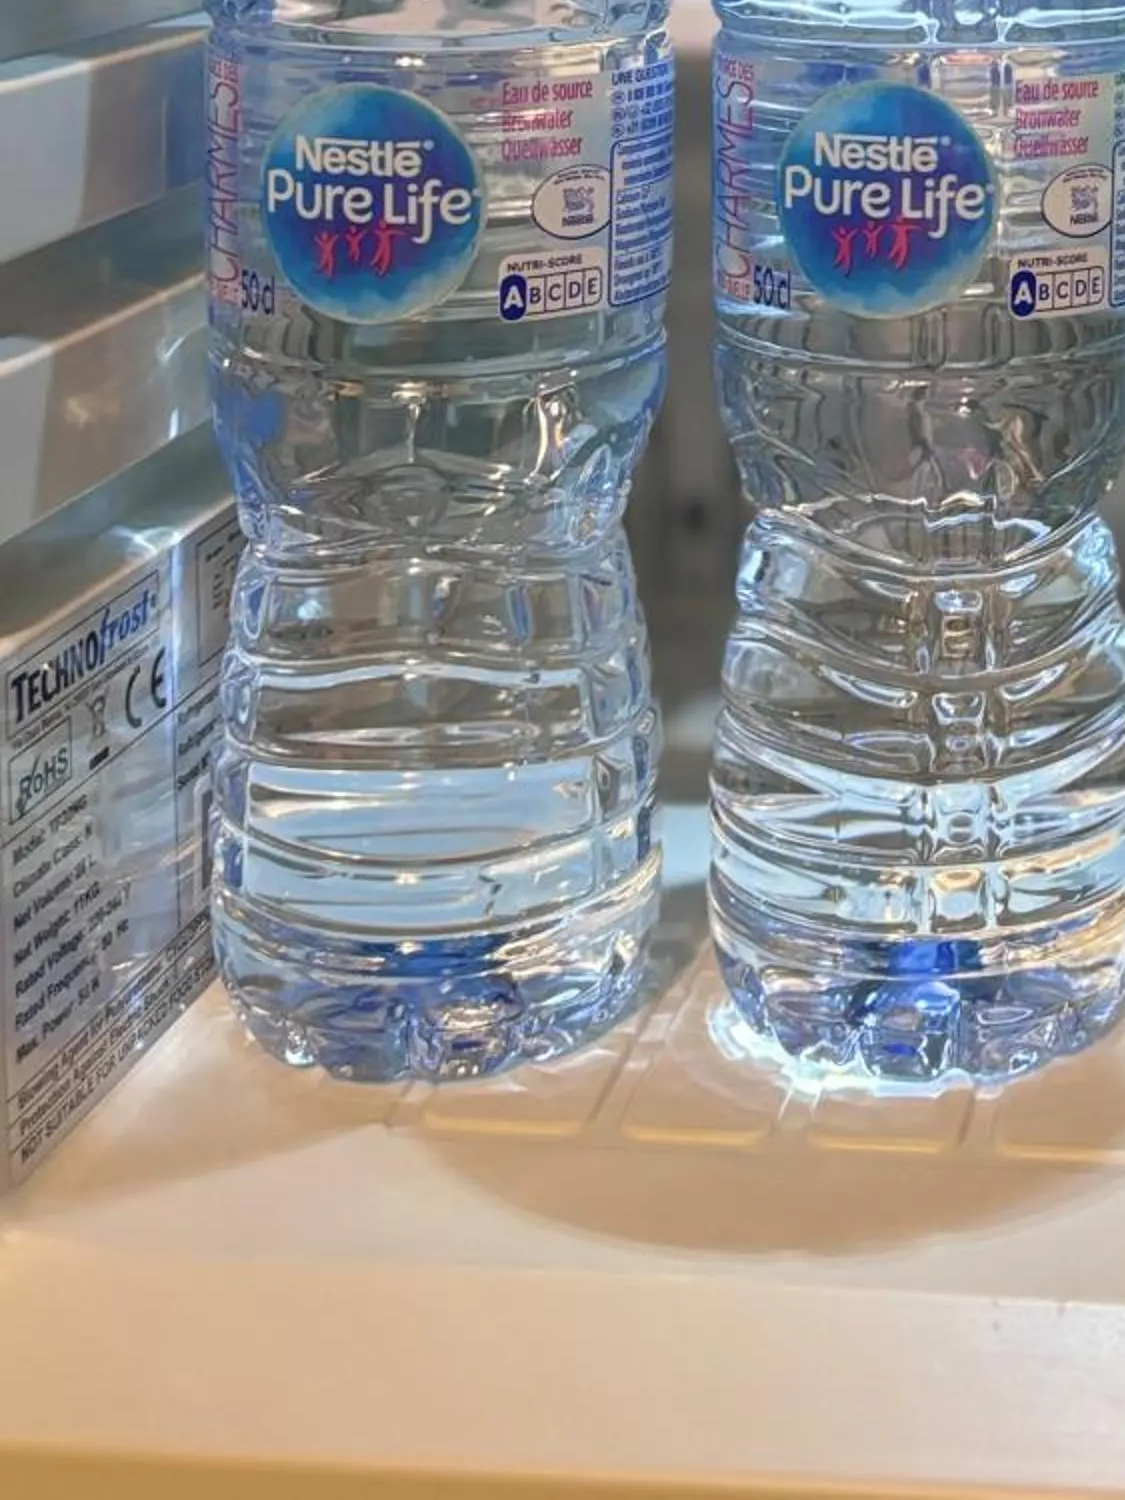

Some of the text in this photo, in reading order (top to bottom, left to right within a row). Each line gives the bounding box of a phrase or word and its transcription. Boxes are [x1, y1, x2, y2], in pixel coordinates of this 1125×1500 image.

[502, 80, 593, 105] Eau de source
[1015, 78, 1099, 104] Eau de source
[294, 135, 424, 179] Nestlé
[812, 130, 939, 173] Nestlé
[266, 168, 474, 244] Pure Life
[784, 164, 987, 240] Pure Life
[506, 253, 583, 273] NUTRI-SCORE
[1016, 251, 1089, 269] NUTRI-SCORE
[505, 278, 598, 311] A B C D E
[1014, 278, 1102, 305] A B C D E
